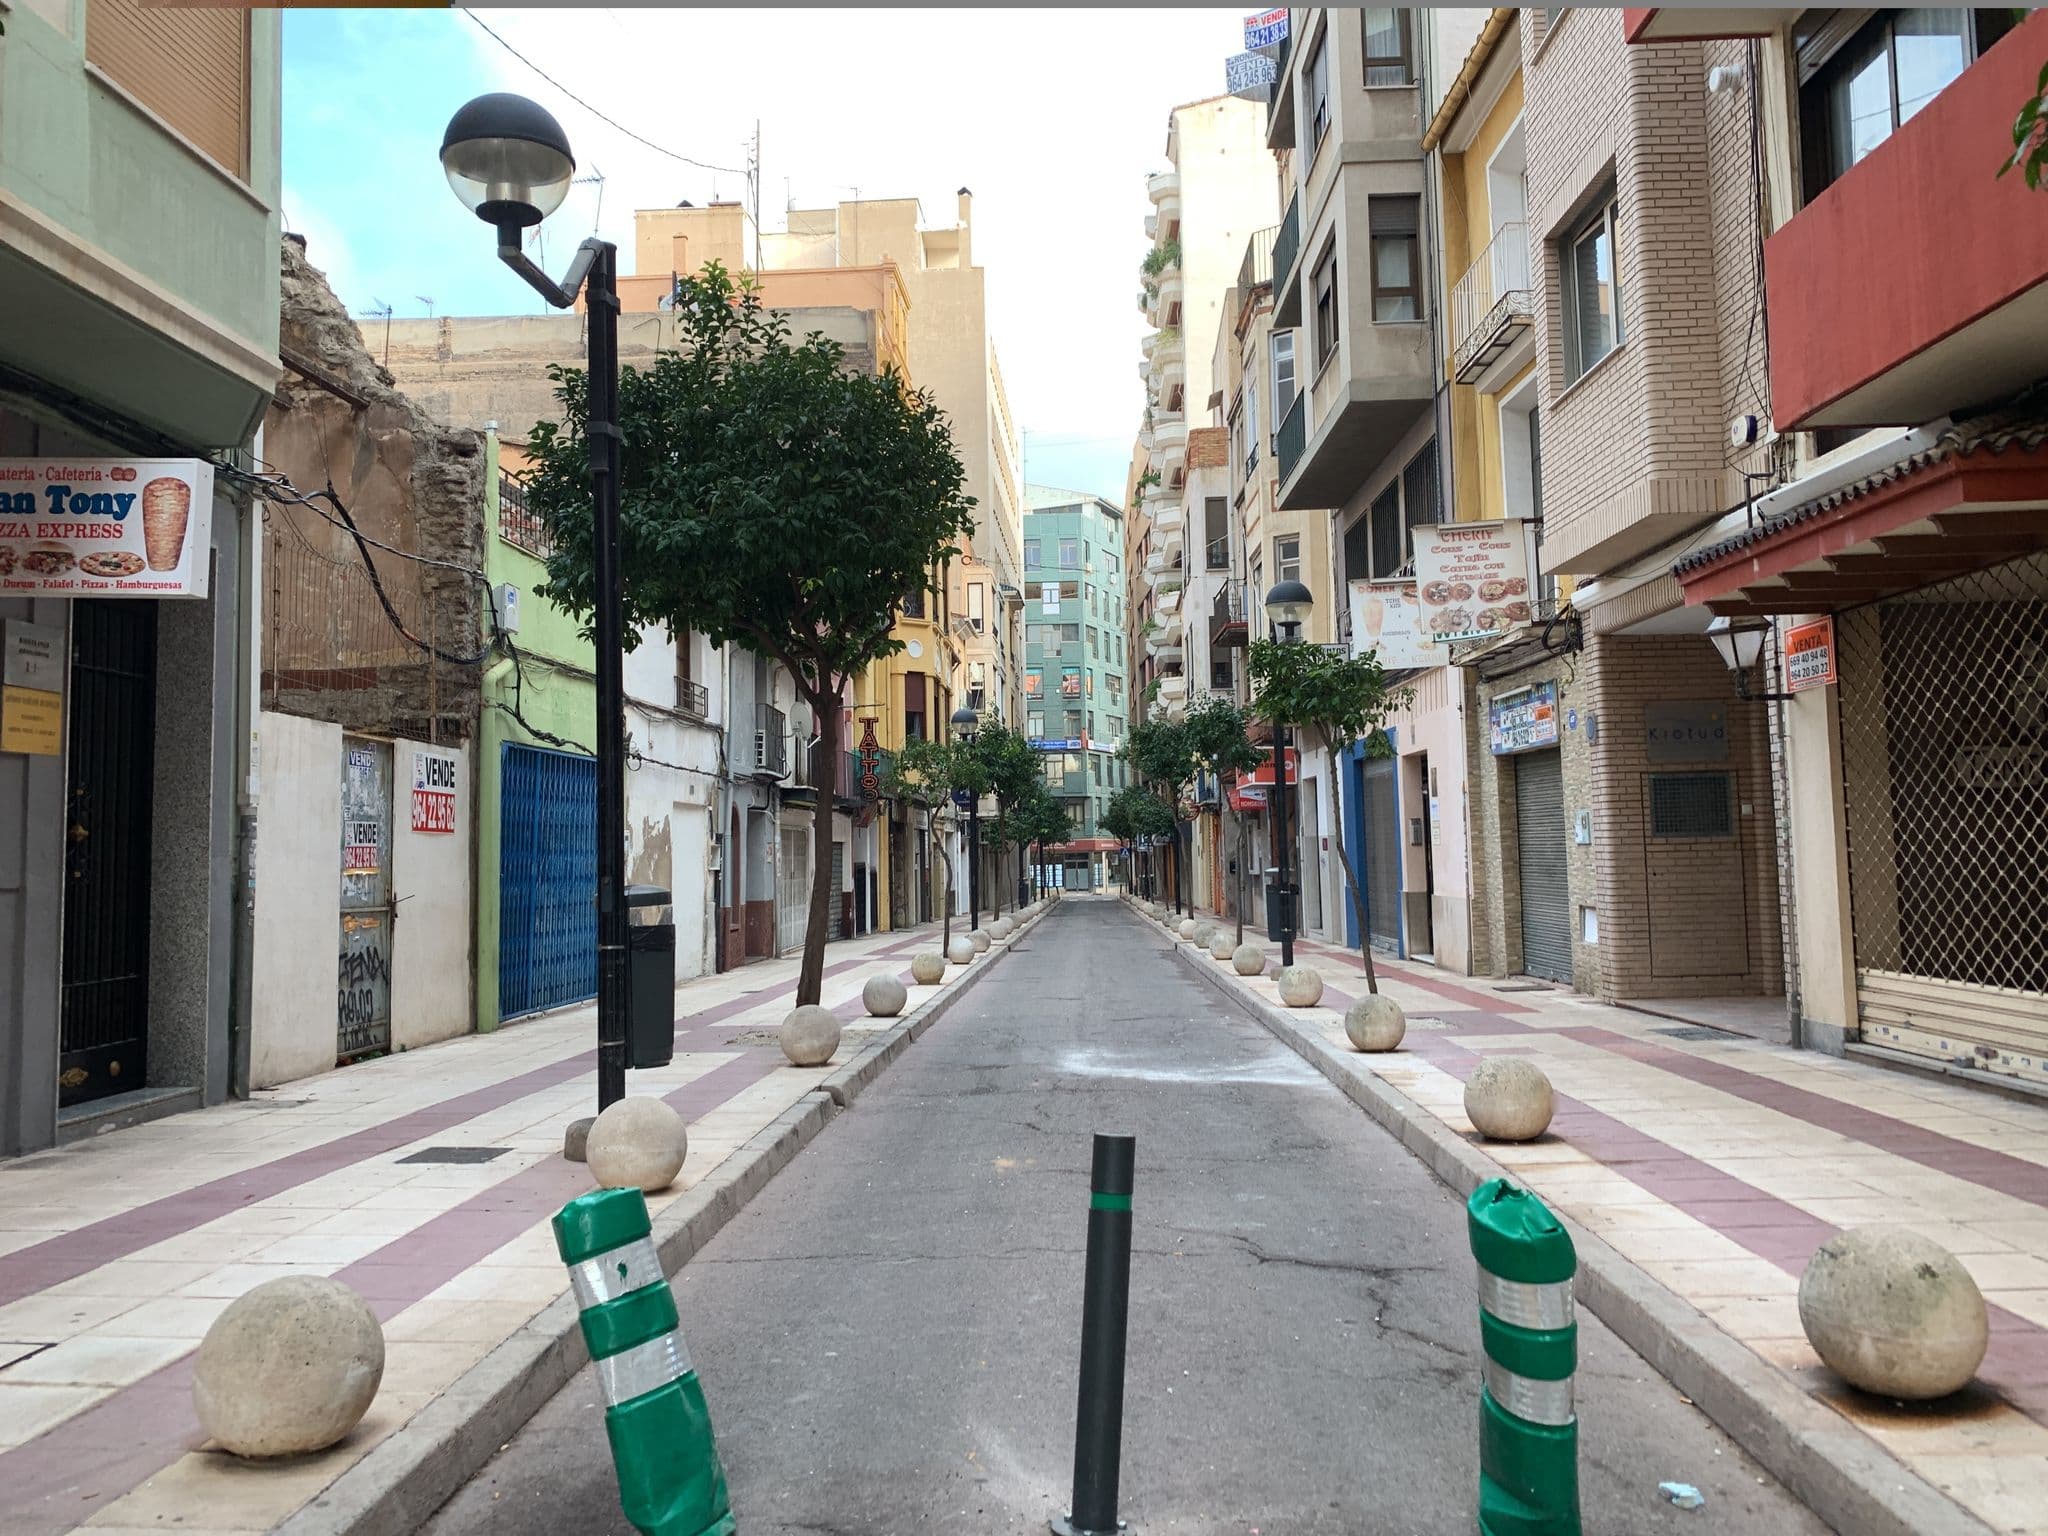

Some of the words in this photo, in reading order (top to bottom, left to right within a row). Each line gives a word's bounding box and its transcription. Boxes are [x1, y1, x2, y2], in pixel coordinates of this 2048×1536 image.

[1261, 8, 1287, 26] VENDE
[1246, 30, 1260, 48] 964
[1260, 27, 1270, 45] 21
[1270, 24, 1280, 42] 38
[1228, 58, 1276, 76] VENDE
[1227, 74, 1242, 93] 964
[1244, 69, 1259, 88] 245
[45, 485, 136, 520] Tony
[37, 523, 123, 539] EXPRESS
[1431, 545, 1463, 554] Cous
[1478, 541, 1511, 550] Cous
[43, 579, 74, 589] Falafel
[81, 580, 109, 589] Pizzas
[116, 580, 183, 590] Hamburguesas
[1793, 635, 1822, 653] VENTA
[1801, 653, 1810, 663] 40
[1810, 650, 1819, 662] 94
[1820, 647, 1828, 659] 48
[1802, 666, 1810, 678] 20
[1811, 664, 1820, 676] 50
[1820, 662, 1829, 674] 22
[859, 717, 879, 800] TATTOO
[425, 756, 455, 789] VENDE
[412, 793, 427, 829] 964
[427, 794, 438, 830] 22
[437, 795, 446, 830] 95
[446, 796, 455, 831] 62
[353, 823, 377, 844] VENDE
[356, 847, 362, 868] 22
[363, 847, 370, 868] 95
